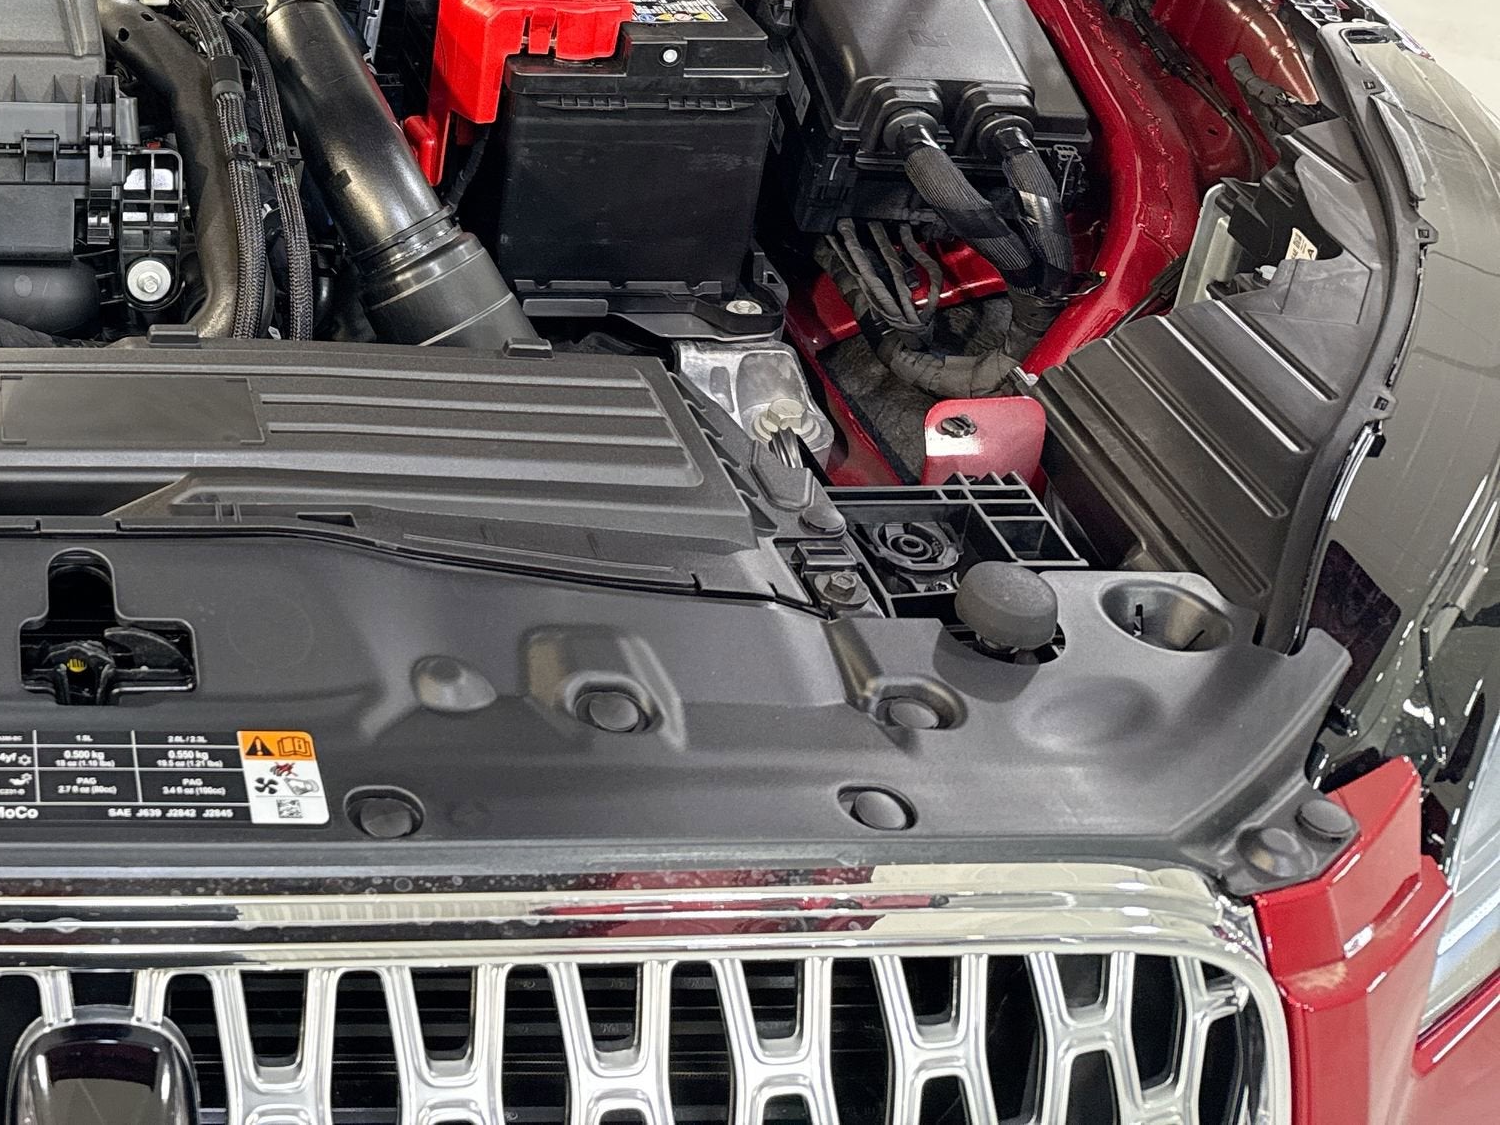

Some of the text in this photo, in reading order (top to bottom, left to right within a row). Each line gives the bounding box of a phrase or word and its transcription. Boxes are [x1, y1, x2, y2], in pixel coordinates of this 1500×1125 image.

[63, 750, 105, 761] 0.500 kg
[167, 750, 209, 760] 0.550 kg
[76, 777, 97, 785] PAG
[182, 778, 203, 786] PAG
[107, 808, 132, 818] SAE
[135, 808, 162, 818] J639
[165, 808, 197, 818] J2842
